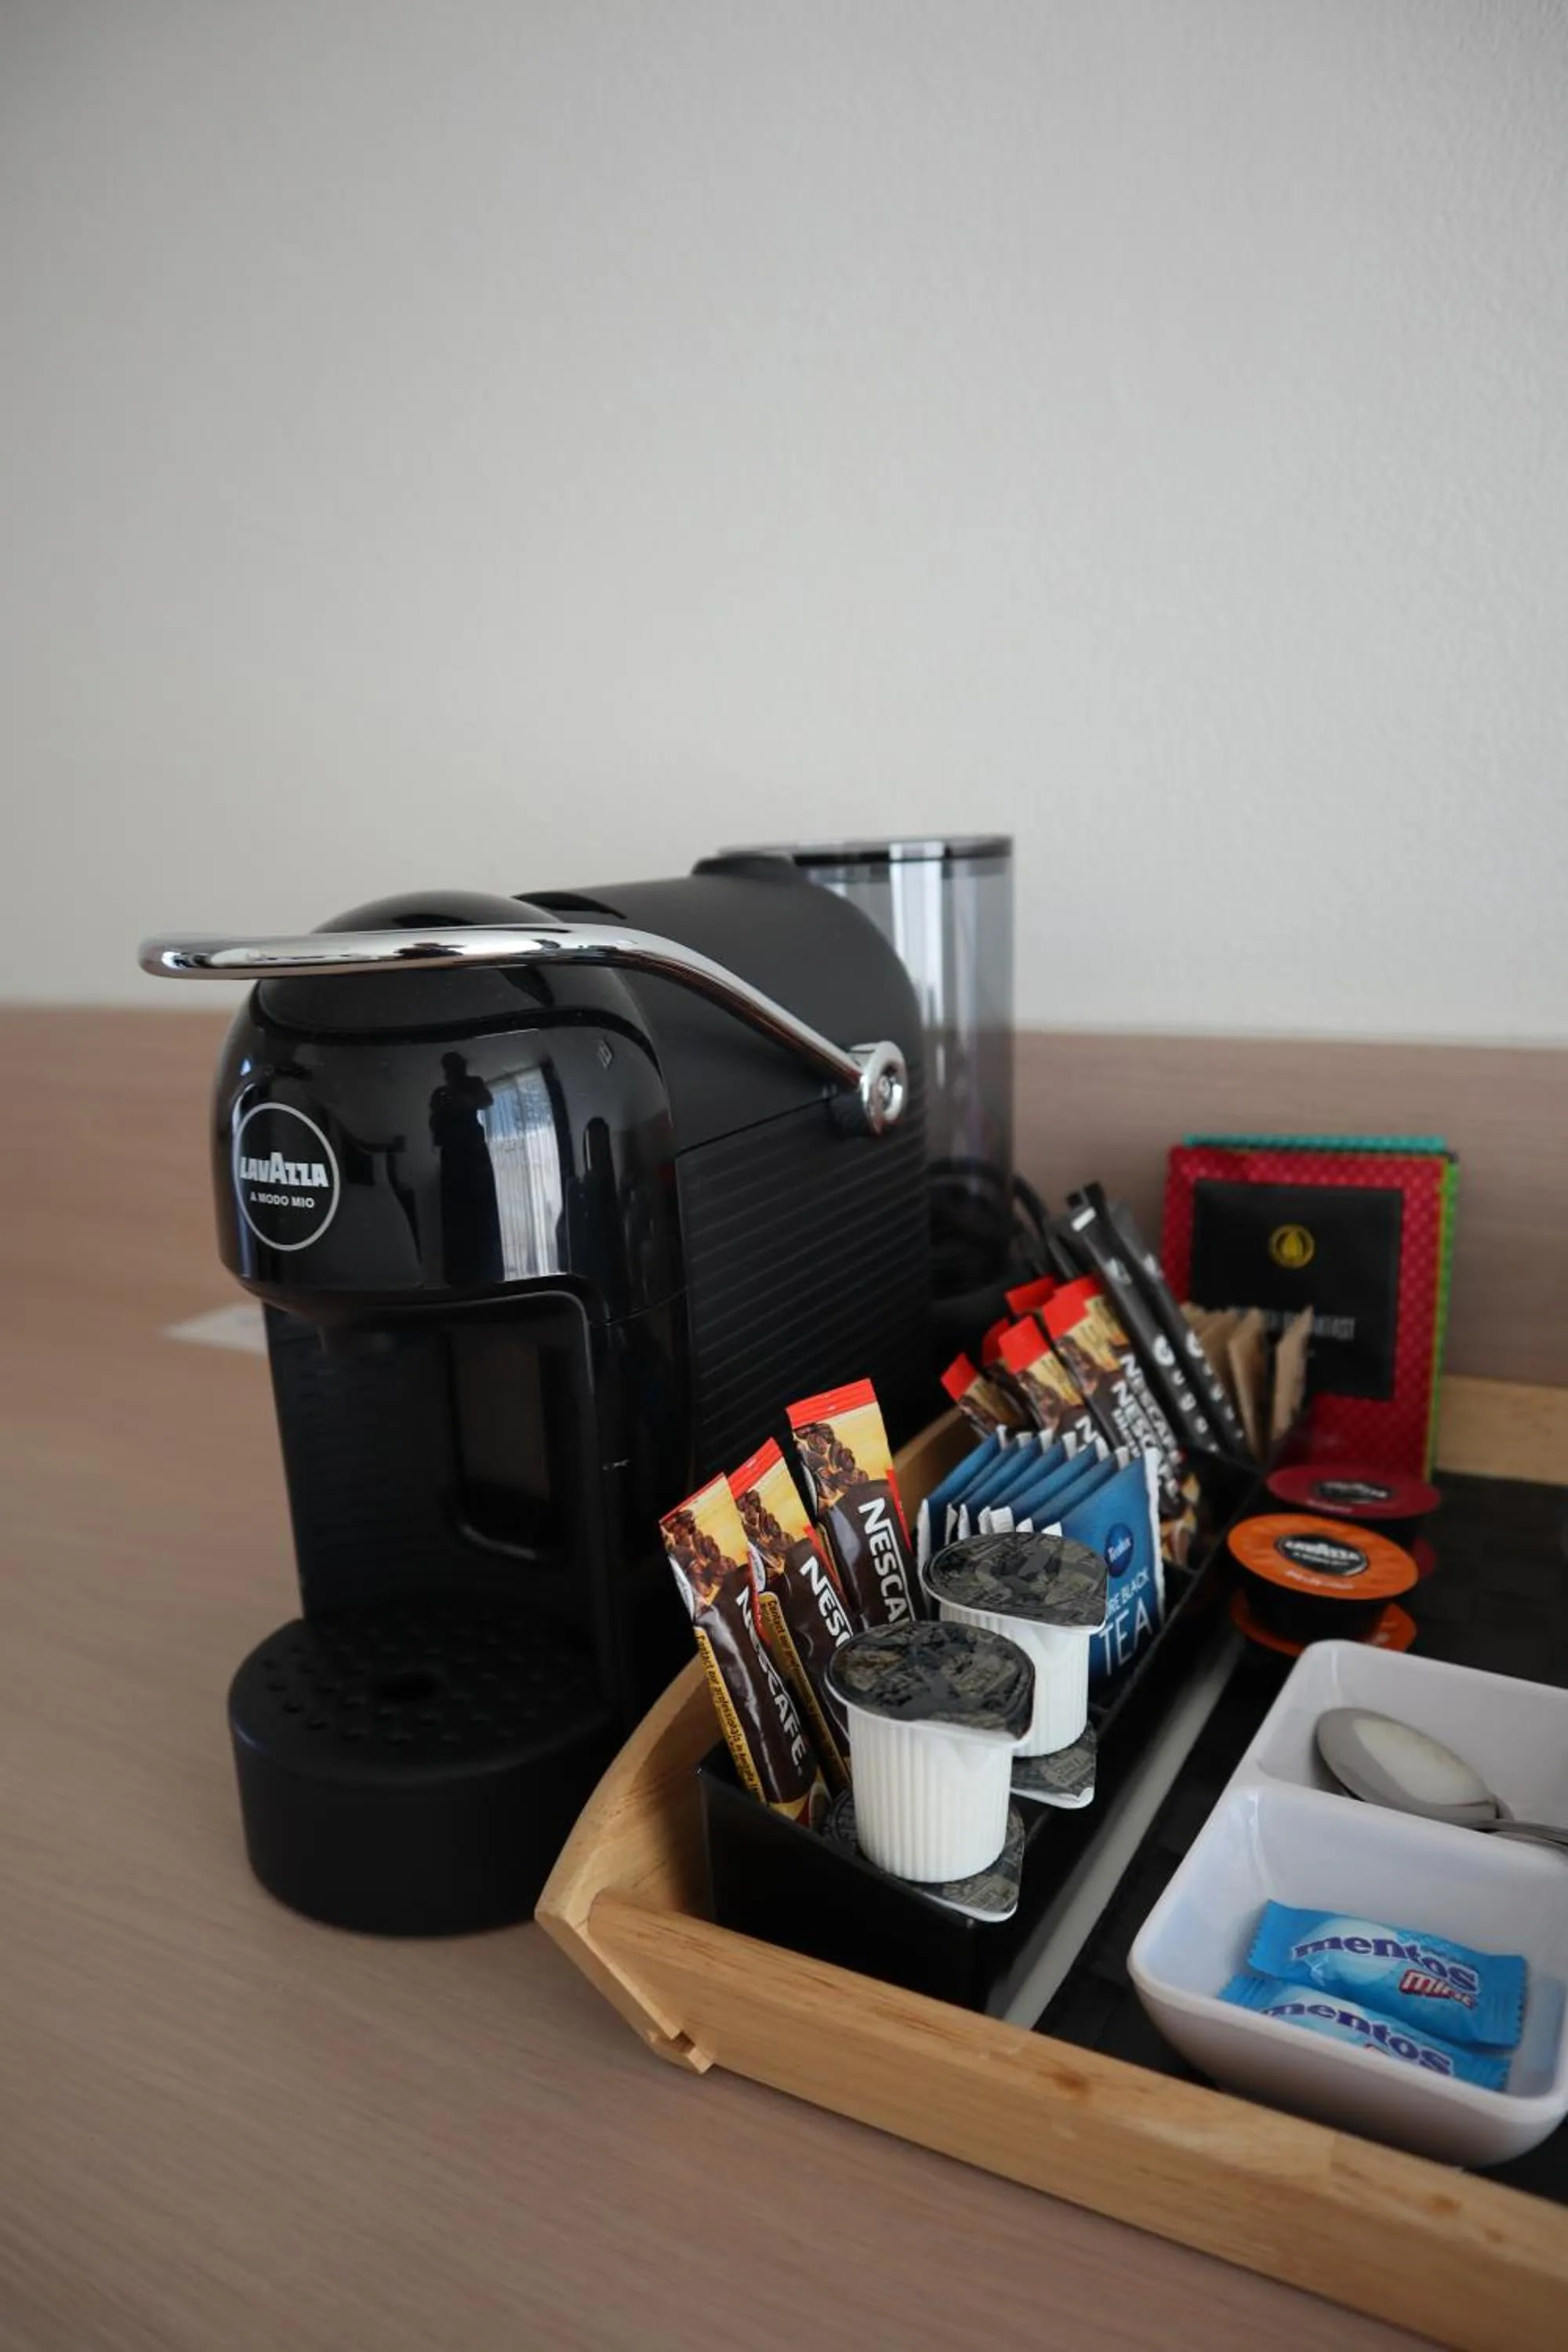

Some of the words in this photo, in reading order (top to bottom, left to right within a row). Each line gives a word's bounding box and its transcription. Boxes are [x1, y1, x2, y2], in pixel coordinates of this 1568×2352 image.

[240, 1152, 329, 1188] LAVAZZA
[250, 1191, 257, 1202] A
[258, 1192, 289, 1207] MODO
[291, 1195, 315, 1208] MIO
[858, 1497, 916, 1623] NESCA
[1098, 1597, 1153, 1676] TEA
[1293, 1934, 1480, 1993] mentos
